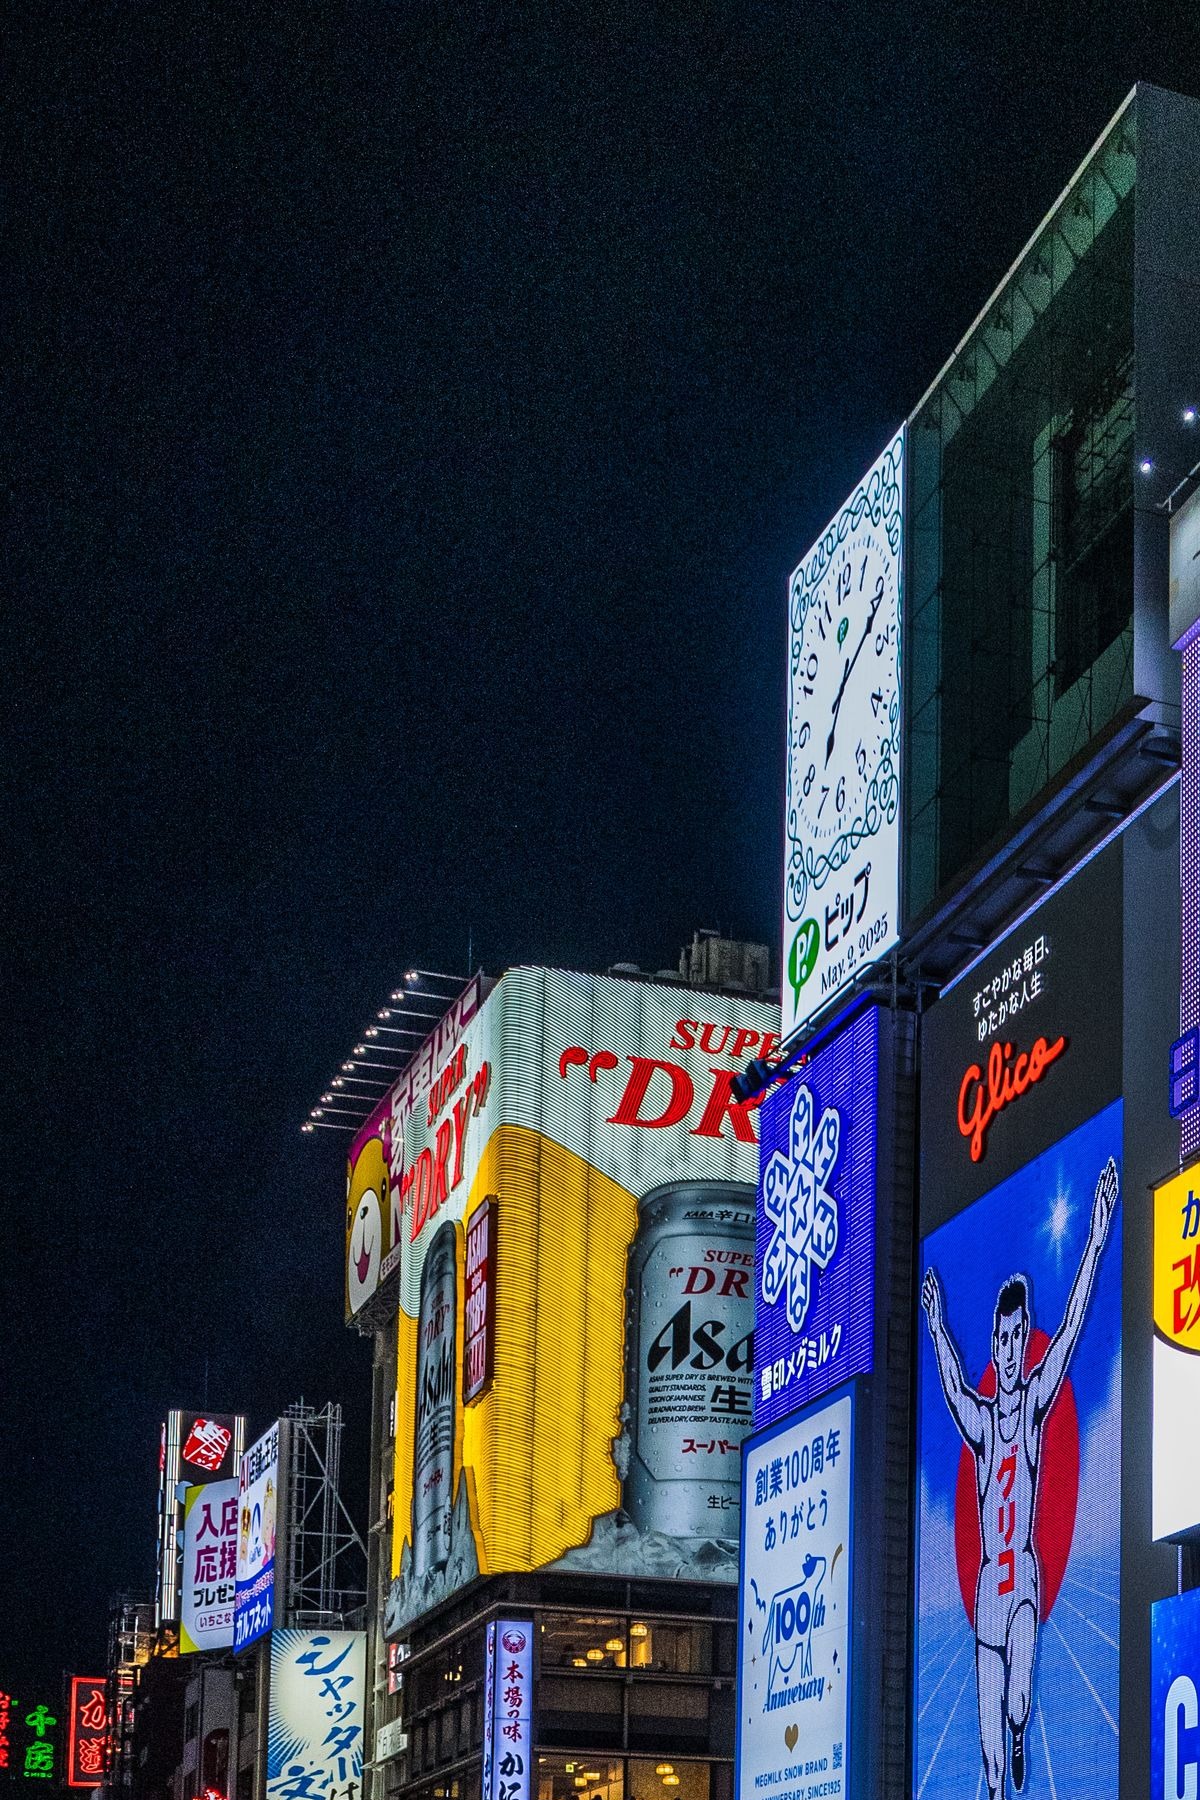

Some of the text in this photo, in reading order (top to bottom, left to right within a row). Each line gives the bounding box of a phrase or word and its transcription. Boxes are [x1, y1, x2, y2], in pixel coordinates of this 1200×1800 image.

[836, 562, 851, 606] 12
[860, 555, 868, 592] 1
[871, 687, 883, 717] 4
[803, 764, 816, 797] 8
[817, 785, 830, 819] 7
[835, 776, 846, 812] 6
[824, 861, 873, 951] ピップ
[859, 912, 888, 960] 2025
[972, 934, 1051, 1018] すこやかな毎日、
[978, 971, 1042, 1042] ゆたかな人生
[670, 1018, 784, 1063] SUPE
[427, 1043, 467, 1127] SUPER
[956, 1034, 1066, 1163] Glico
[704, 1250, 757, 1267] SUPE
[665, 1374, 684, 1382] SUPER
[685, 1373, 698, 1381] DRY
[707, 1374, 736, 1384] BREWED
[761, 1323, 841, 1401] 雪印メグミルク
[710, 1385, 753, 1416] 生
[682, 1438, 739, 1455] スーパー
[755, 1428, 841, 1507] 創業100周年
[764, 1490, 829, 1553] ありがとう
[996, 1442, 1019, 1597] グリコ
[502, 1660, 524, 1743] 本場の味
[762, 1676, 825, 1713] Anniversary
[755, 1757, 828, 1789] MEGMILK SNOW BRAND
